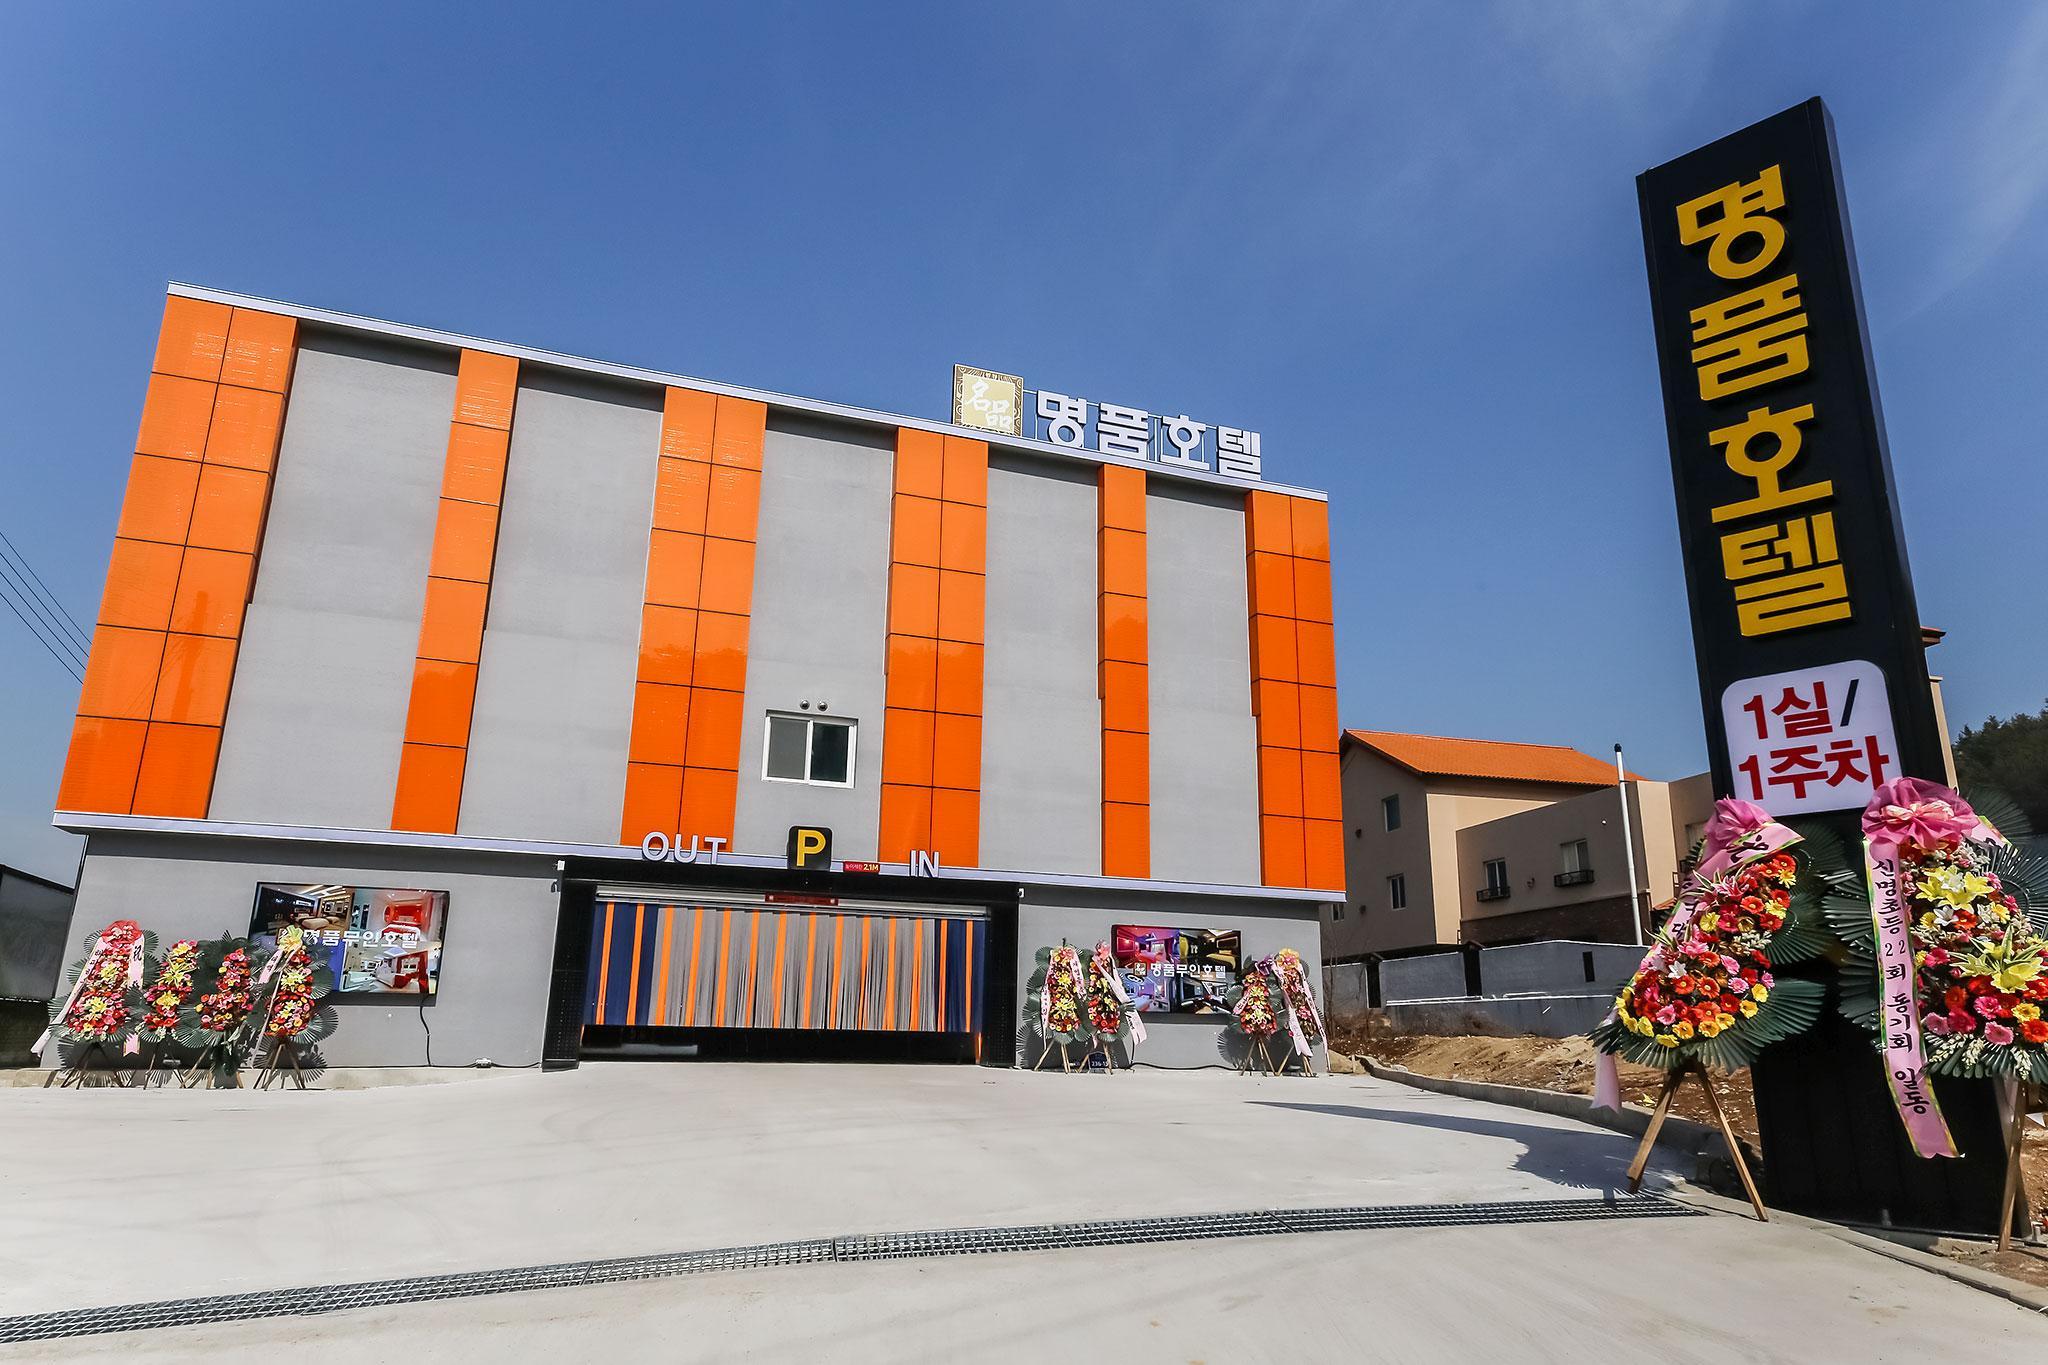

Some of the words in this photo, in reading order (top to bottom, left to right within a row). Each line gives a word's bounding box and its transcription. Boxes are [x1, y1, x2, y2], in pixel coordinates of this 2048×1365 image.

[1675, 163, 1853, 637] 명품호텔
[1036, 389, 1262, 480] 명품호텔
[1738, 735, 1890, 801] 1주차
[641, 831, 727, 865] OUT
[796, 829, 826, 867] P
[909, 850, 940, 878] IN
[1150, 963, 1226, 979] 명품무인호텔
